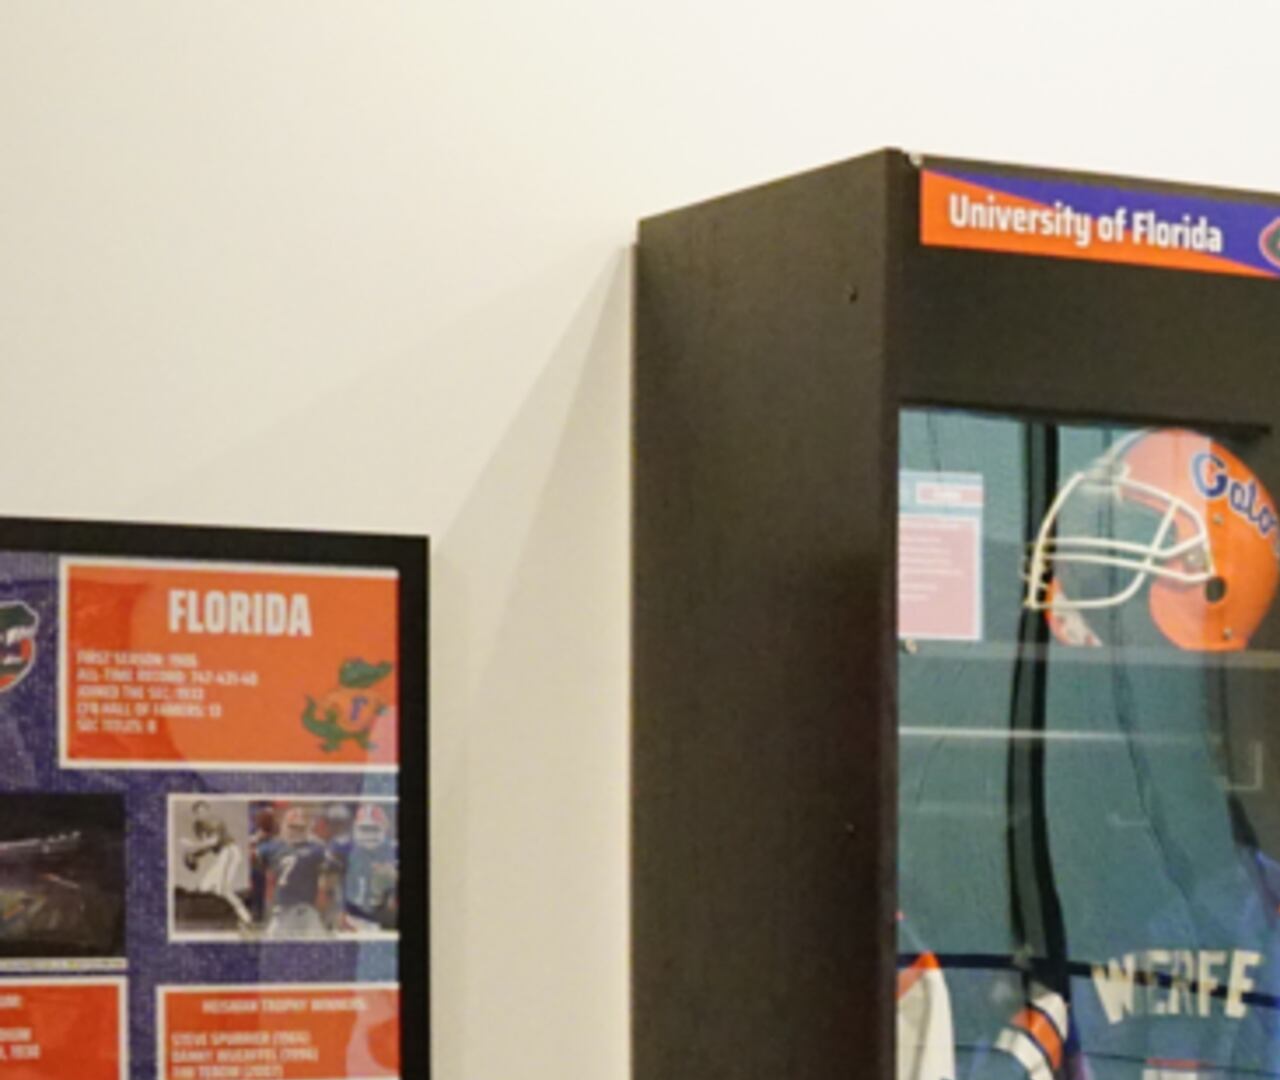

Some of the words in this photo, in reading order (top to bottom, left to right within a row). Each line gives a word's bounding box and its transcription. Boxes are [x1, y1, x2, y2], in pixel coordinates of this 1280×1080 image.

[948, 194, 1091, 247] University
[1098, 209, 1128, 240] of
[1132, 212, 1223, 252] Florida
[167, 588, 312, 637] FLORIDA
